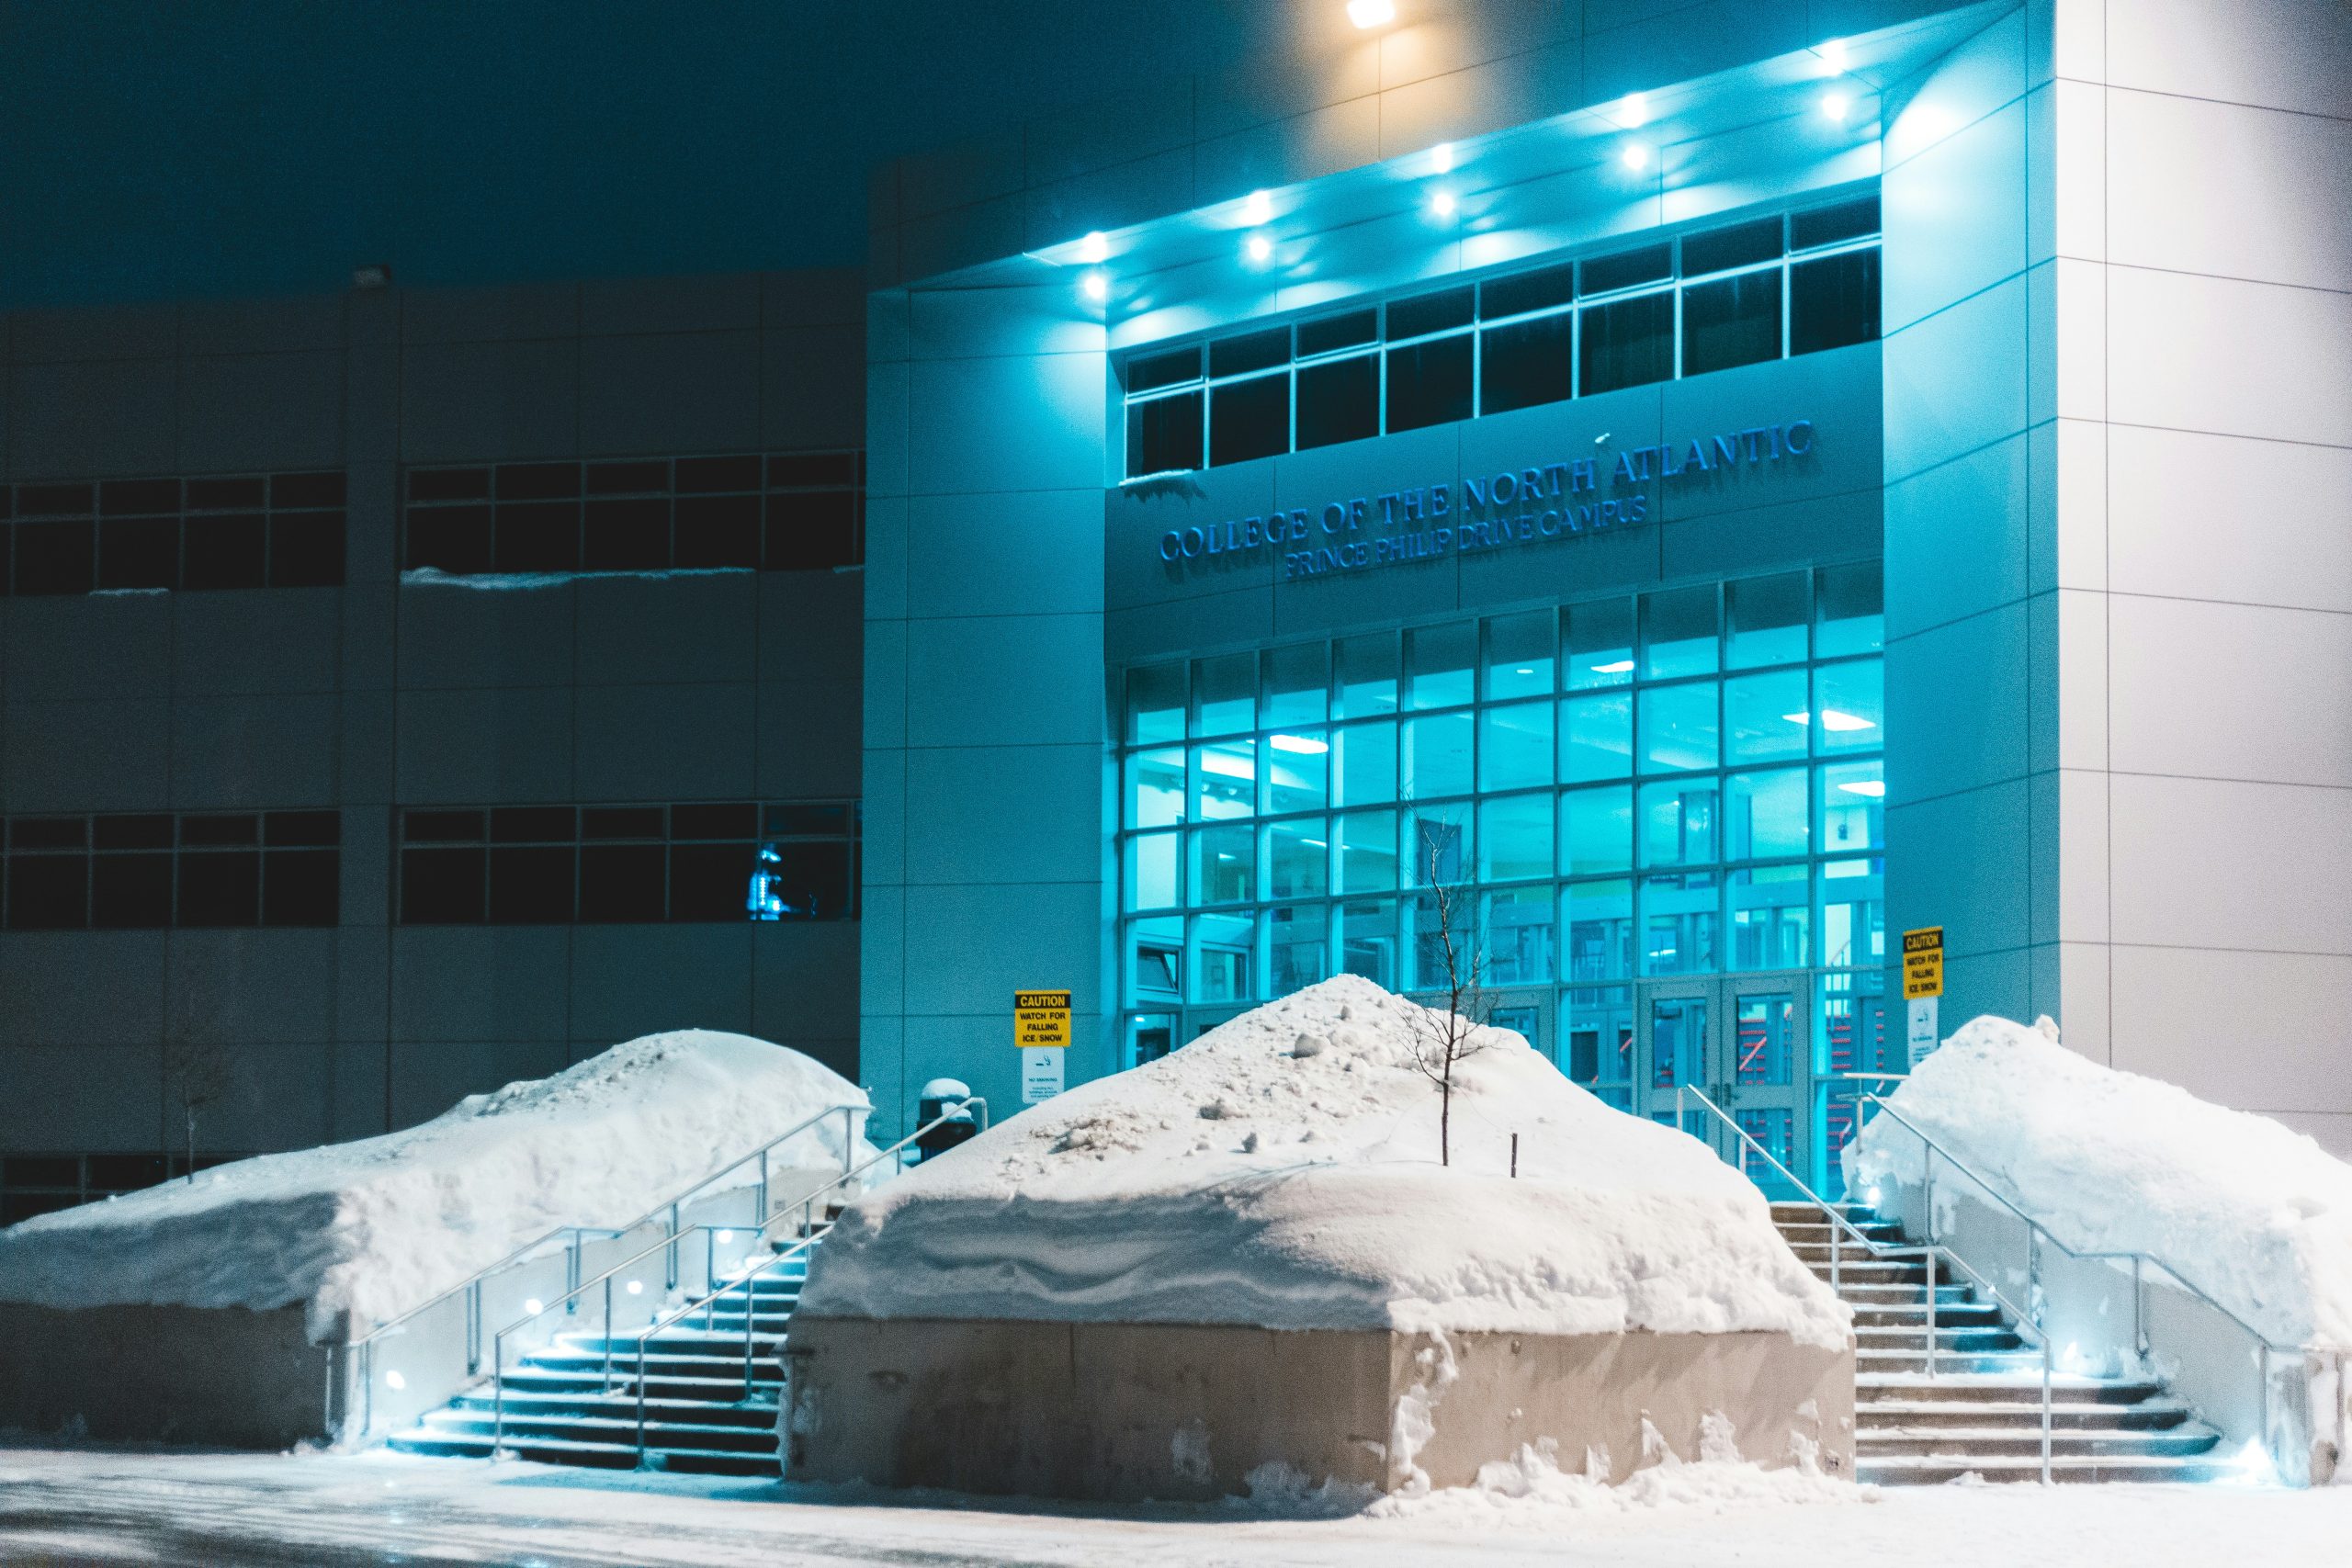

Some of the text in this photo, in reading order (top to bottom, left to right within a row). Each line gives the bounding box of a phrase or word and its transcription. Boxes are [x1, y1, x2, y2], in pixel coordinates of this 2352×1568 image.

[1159, 419, 1814, 562] COLLEGE OF THE NORTH ATLANTIC
[1284, 495, 1647, 580] PRINCE PHILIP DRIVE CAMPUS
[1906, 933, 1939, 951] CAUTION
[1907, 953, 1939, 965] WATCH FOR
[1912, 968, 1934, 978] FALLING
[1020, 995, 1066, 1007] CAUTION
[1049, 1011, 1066, 1020] FOR
